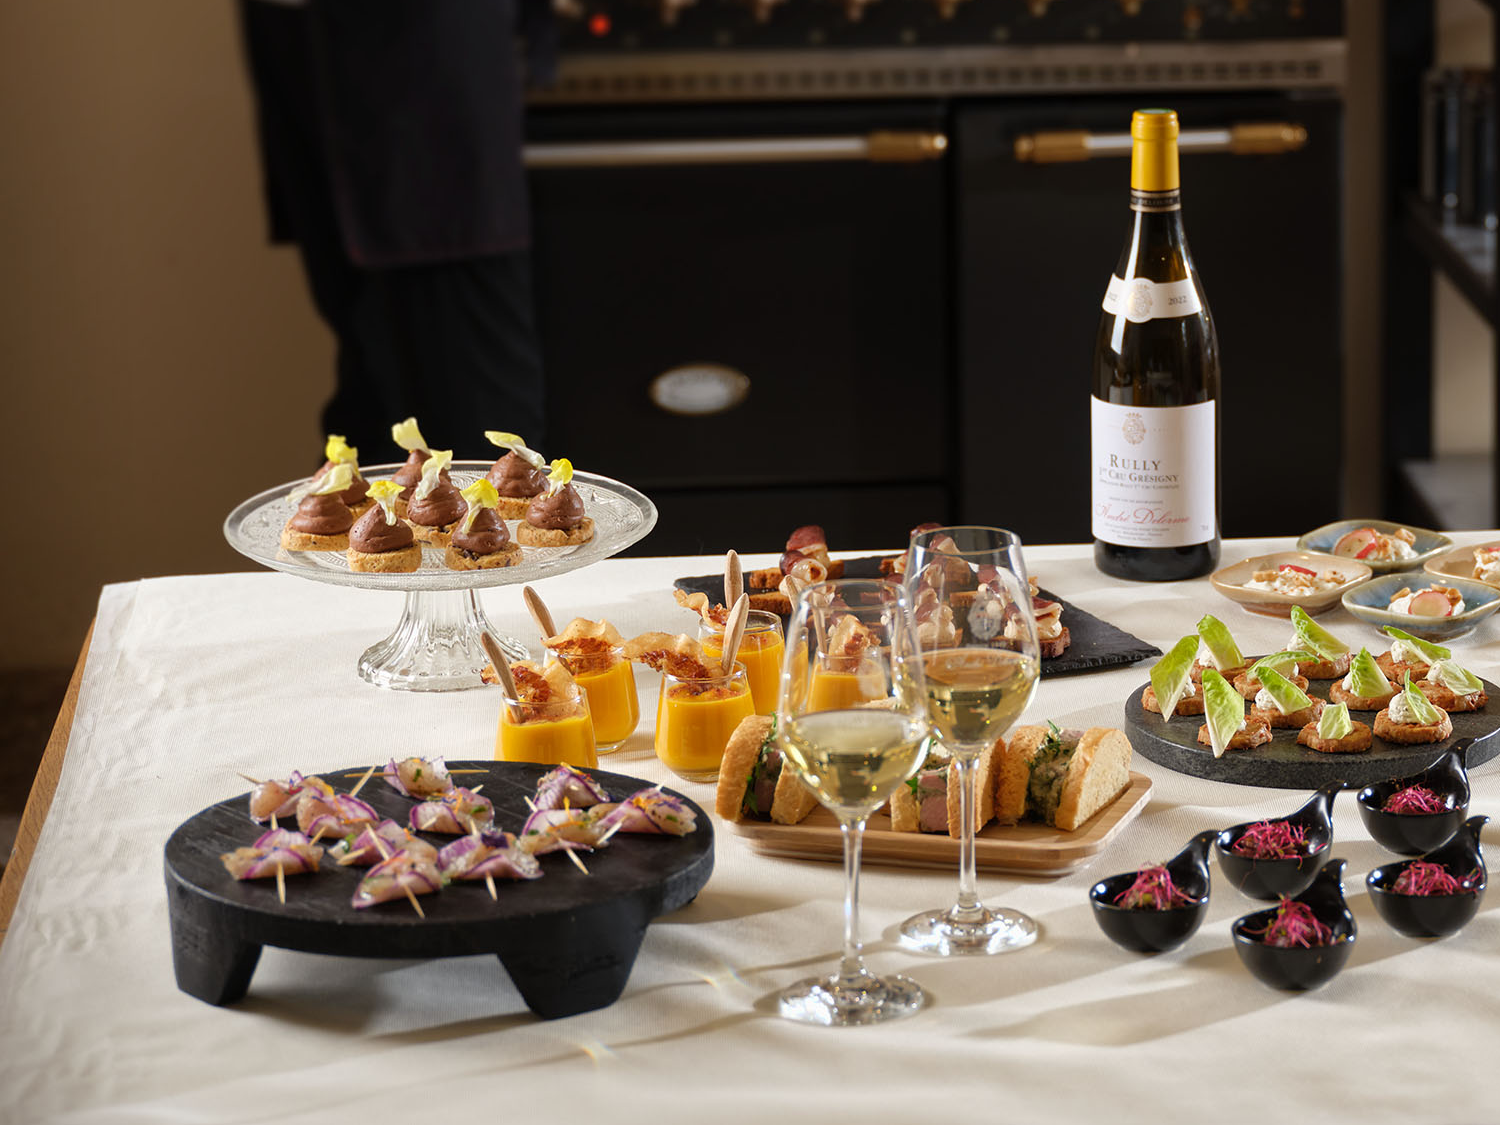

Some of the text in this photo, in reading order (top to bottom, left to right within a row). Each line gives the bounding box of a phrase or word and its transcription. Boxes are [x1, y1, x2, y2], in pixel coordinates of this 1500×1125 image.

[1168, 296, 1187, 306] 2022
[1110, 454, 1160, 471] RULLY
[1096, 504, 1190, 524] André Delorme
